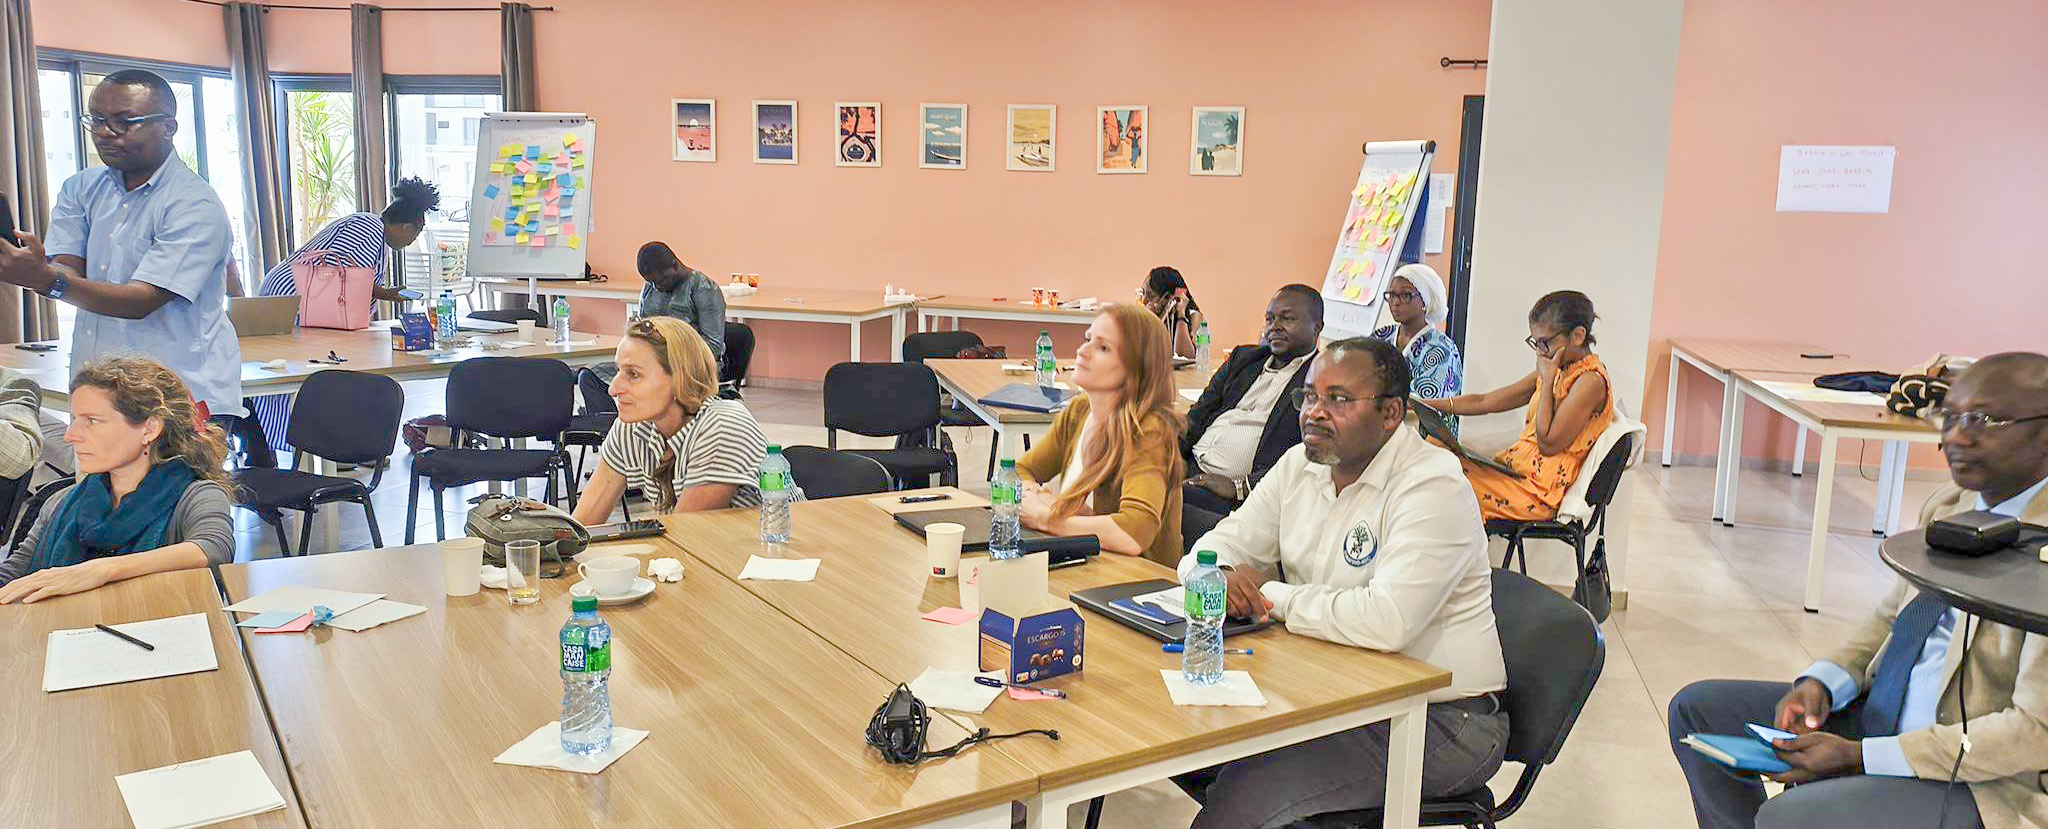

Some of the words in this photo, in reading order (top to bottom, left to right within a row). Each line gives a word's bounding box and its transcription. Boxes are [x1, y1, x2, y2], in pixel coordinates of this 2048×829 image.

[562, 643, 584, 654] CASA
[563, 651, 584, 661] MAN
[563, 658, 585, 668] CAISE
